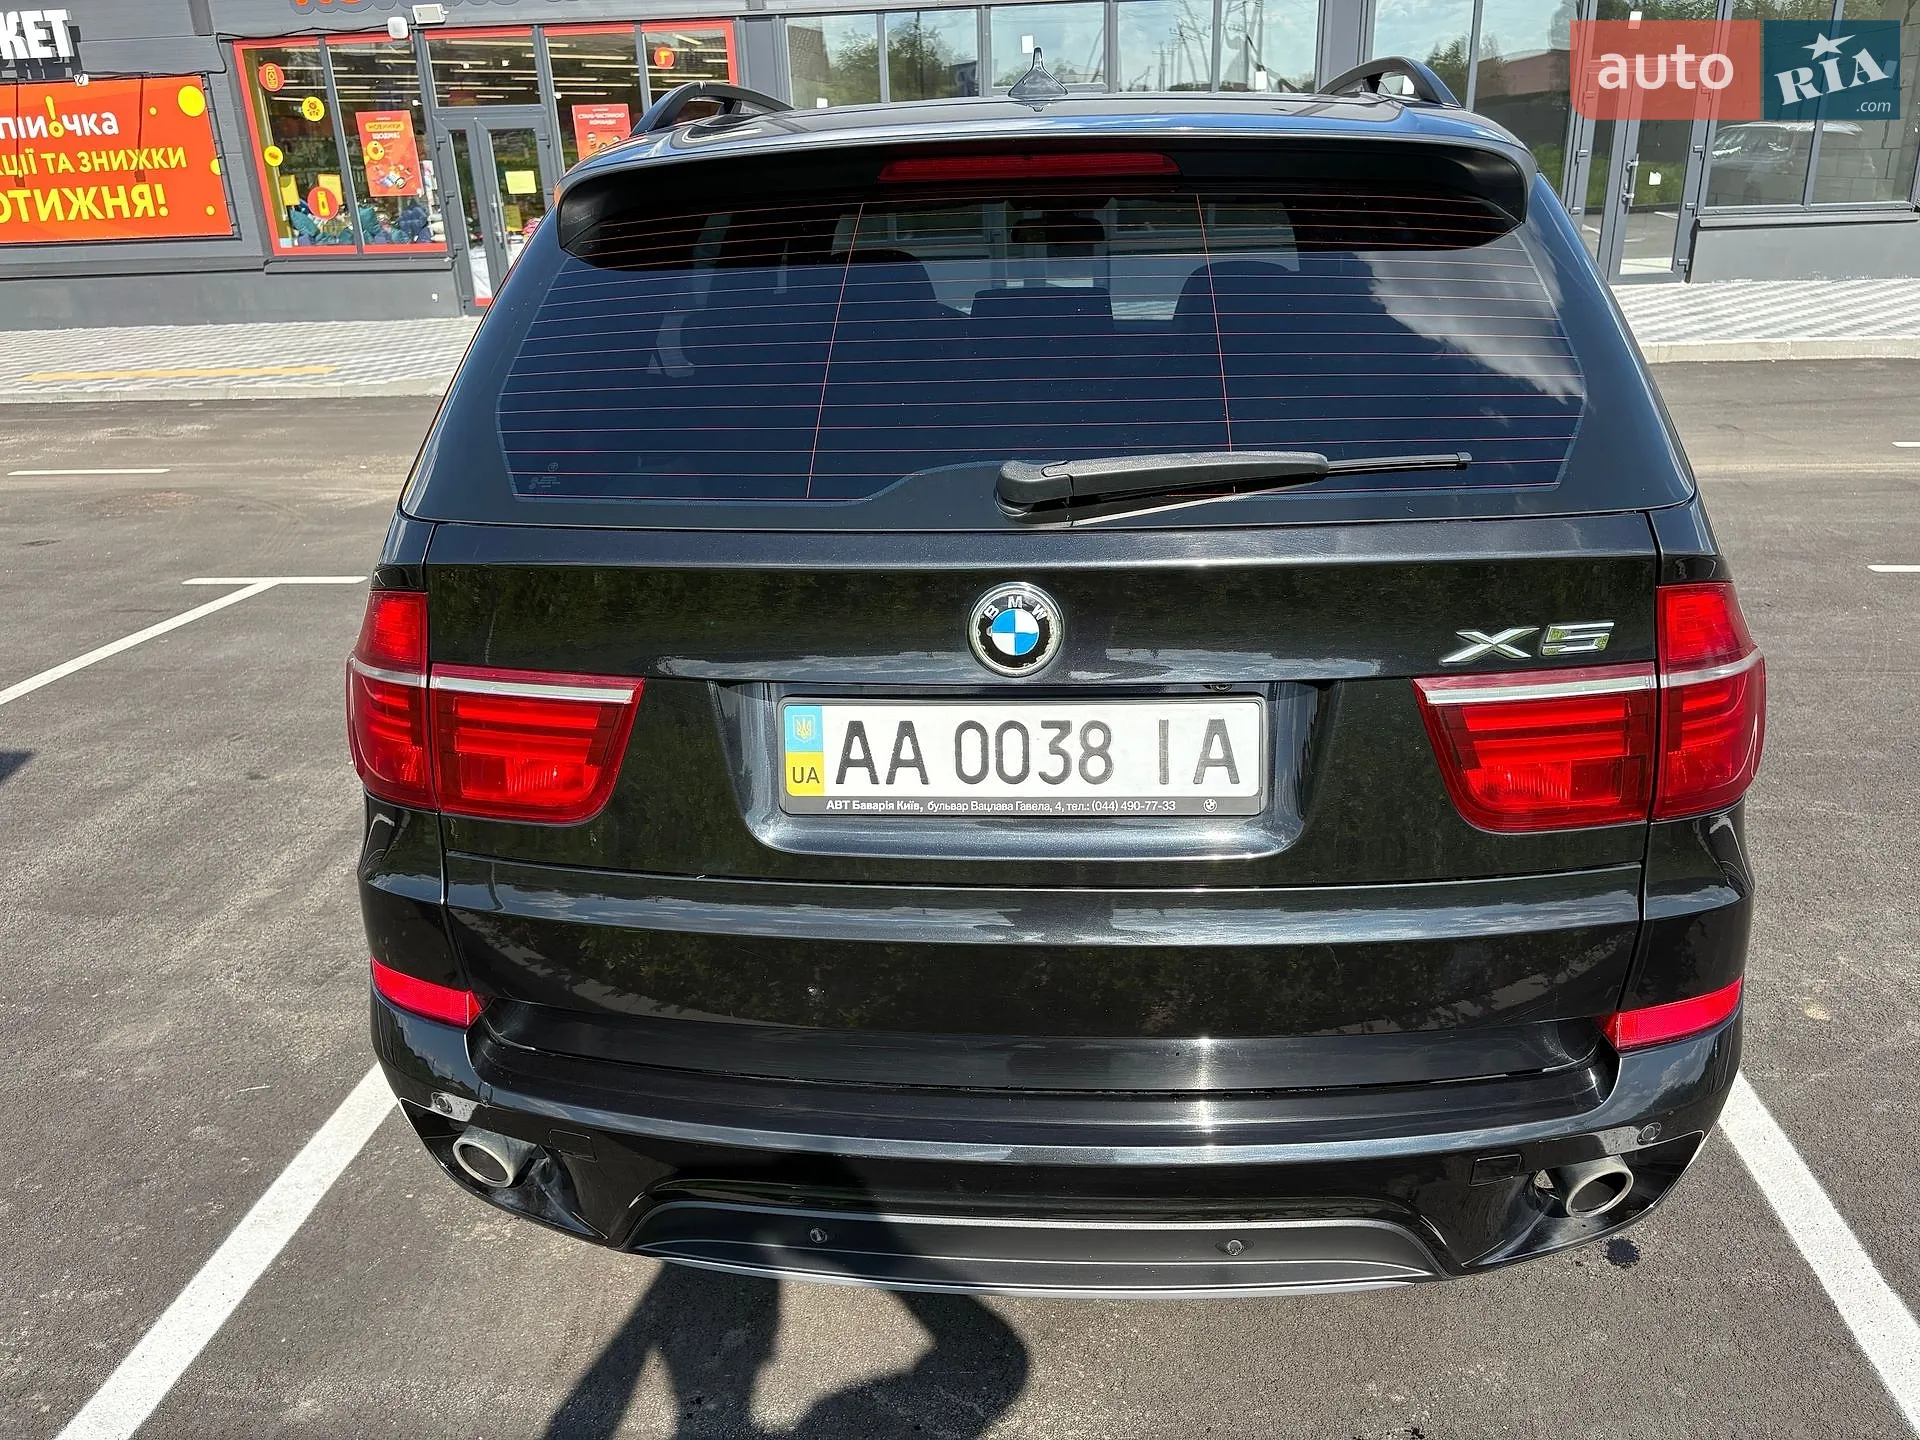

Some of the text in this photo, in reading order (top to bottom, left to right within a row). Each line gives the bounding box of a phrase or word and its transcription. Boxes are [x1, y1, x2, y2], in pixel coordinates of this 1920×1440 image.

[0, 146, 187, 178] ЦІЇ ТА ЗНИЖКИ
[984, 595, 1047, 621] BMW
[1441, 622, 1614, 664] X5
[835, 718, 1240, 785] AA 0038 IA
[792, 766, 820, 784] UA
[826, 800, 1177, 813] АВТ Баварія Київ, бульвар Вацлава Гавела, 4, тел.: (044) 490-77-33
